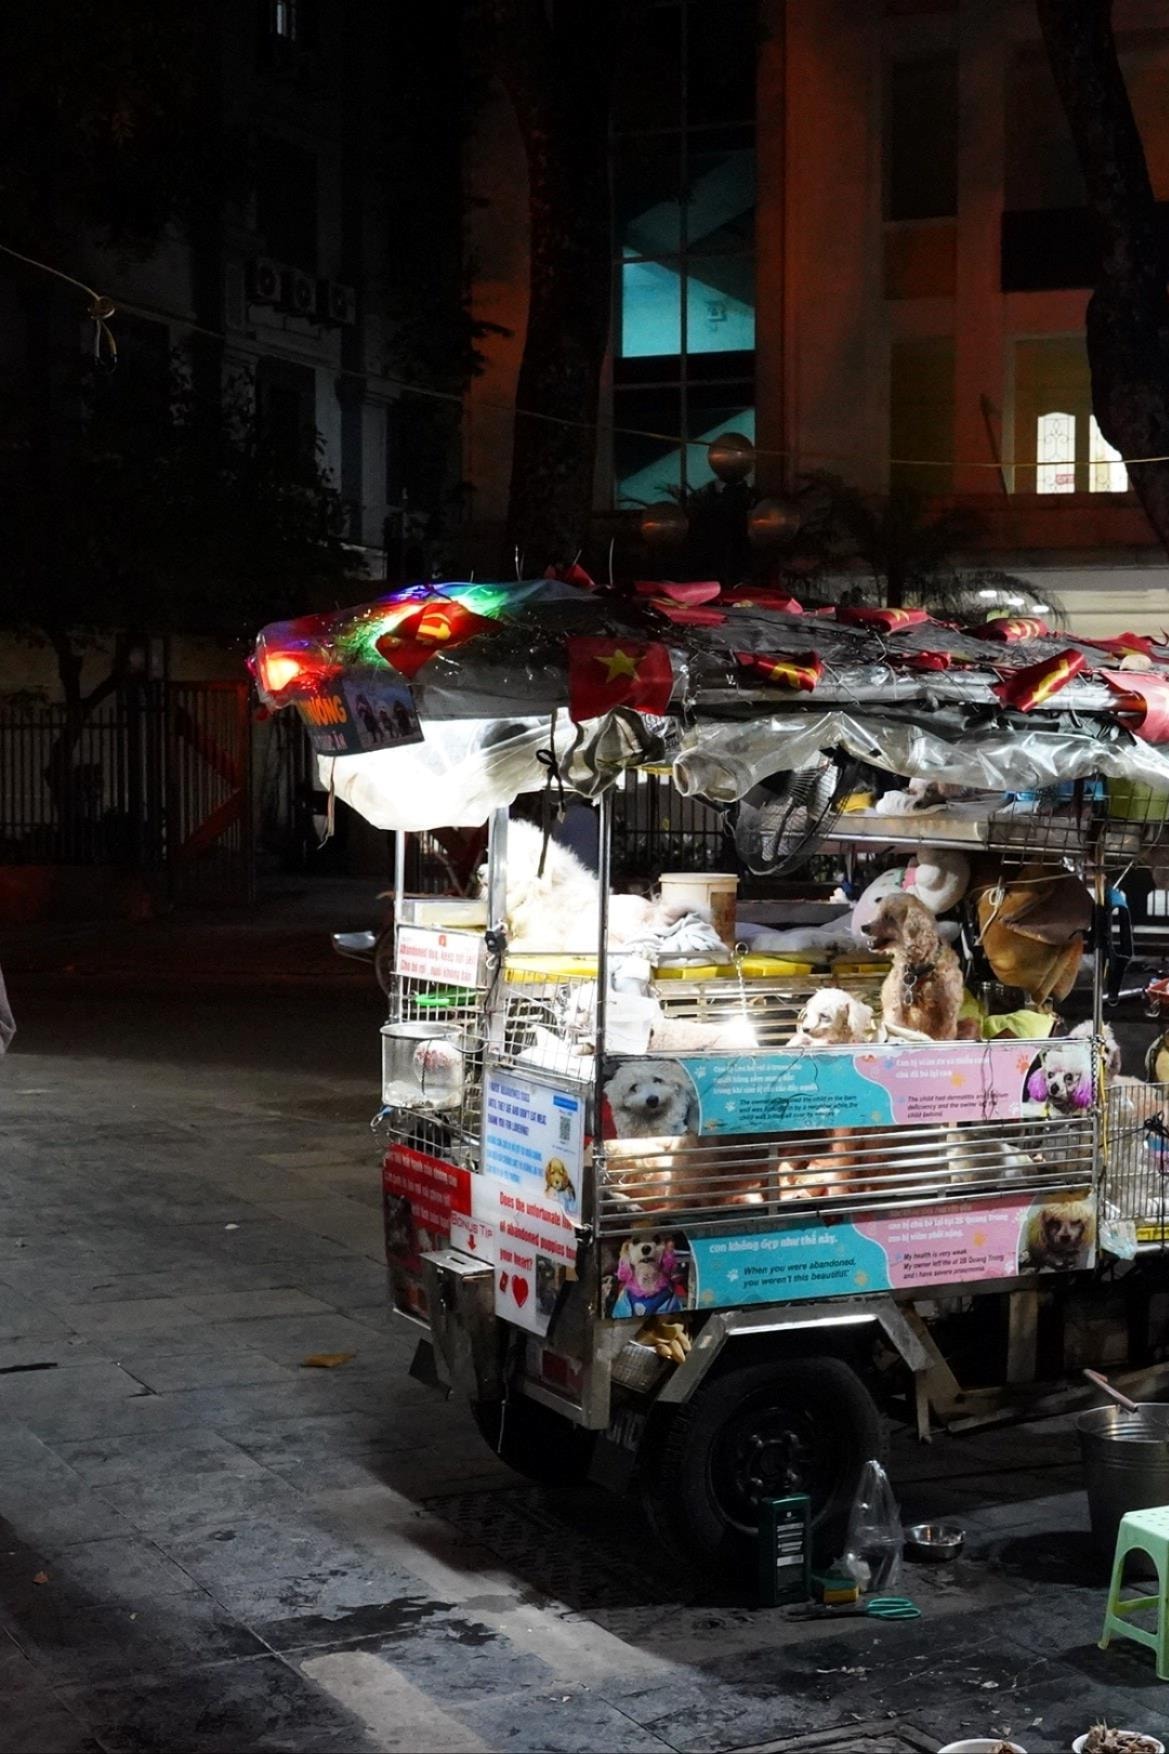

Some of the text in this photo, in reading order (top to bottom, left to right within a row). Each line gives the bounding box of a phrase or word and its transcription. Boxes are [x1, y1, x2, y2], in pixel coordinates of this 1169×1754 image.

[499, 1191, 514, 1208] Does
[515, 1197, 525, 1212] the
[507, 1223, 540, 1246] abandoned
[743, 1265, 767, 1275] When
[769, 1264, 786, 1275] you
[787, 1262, 808, 1271] were
[743, 1279, 760, 1289] you
[794, 1272, 809, 1282] this
